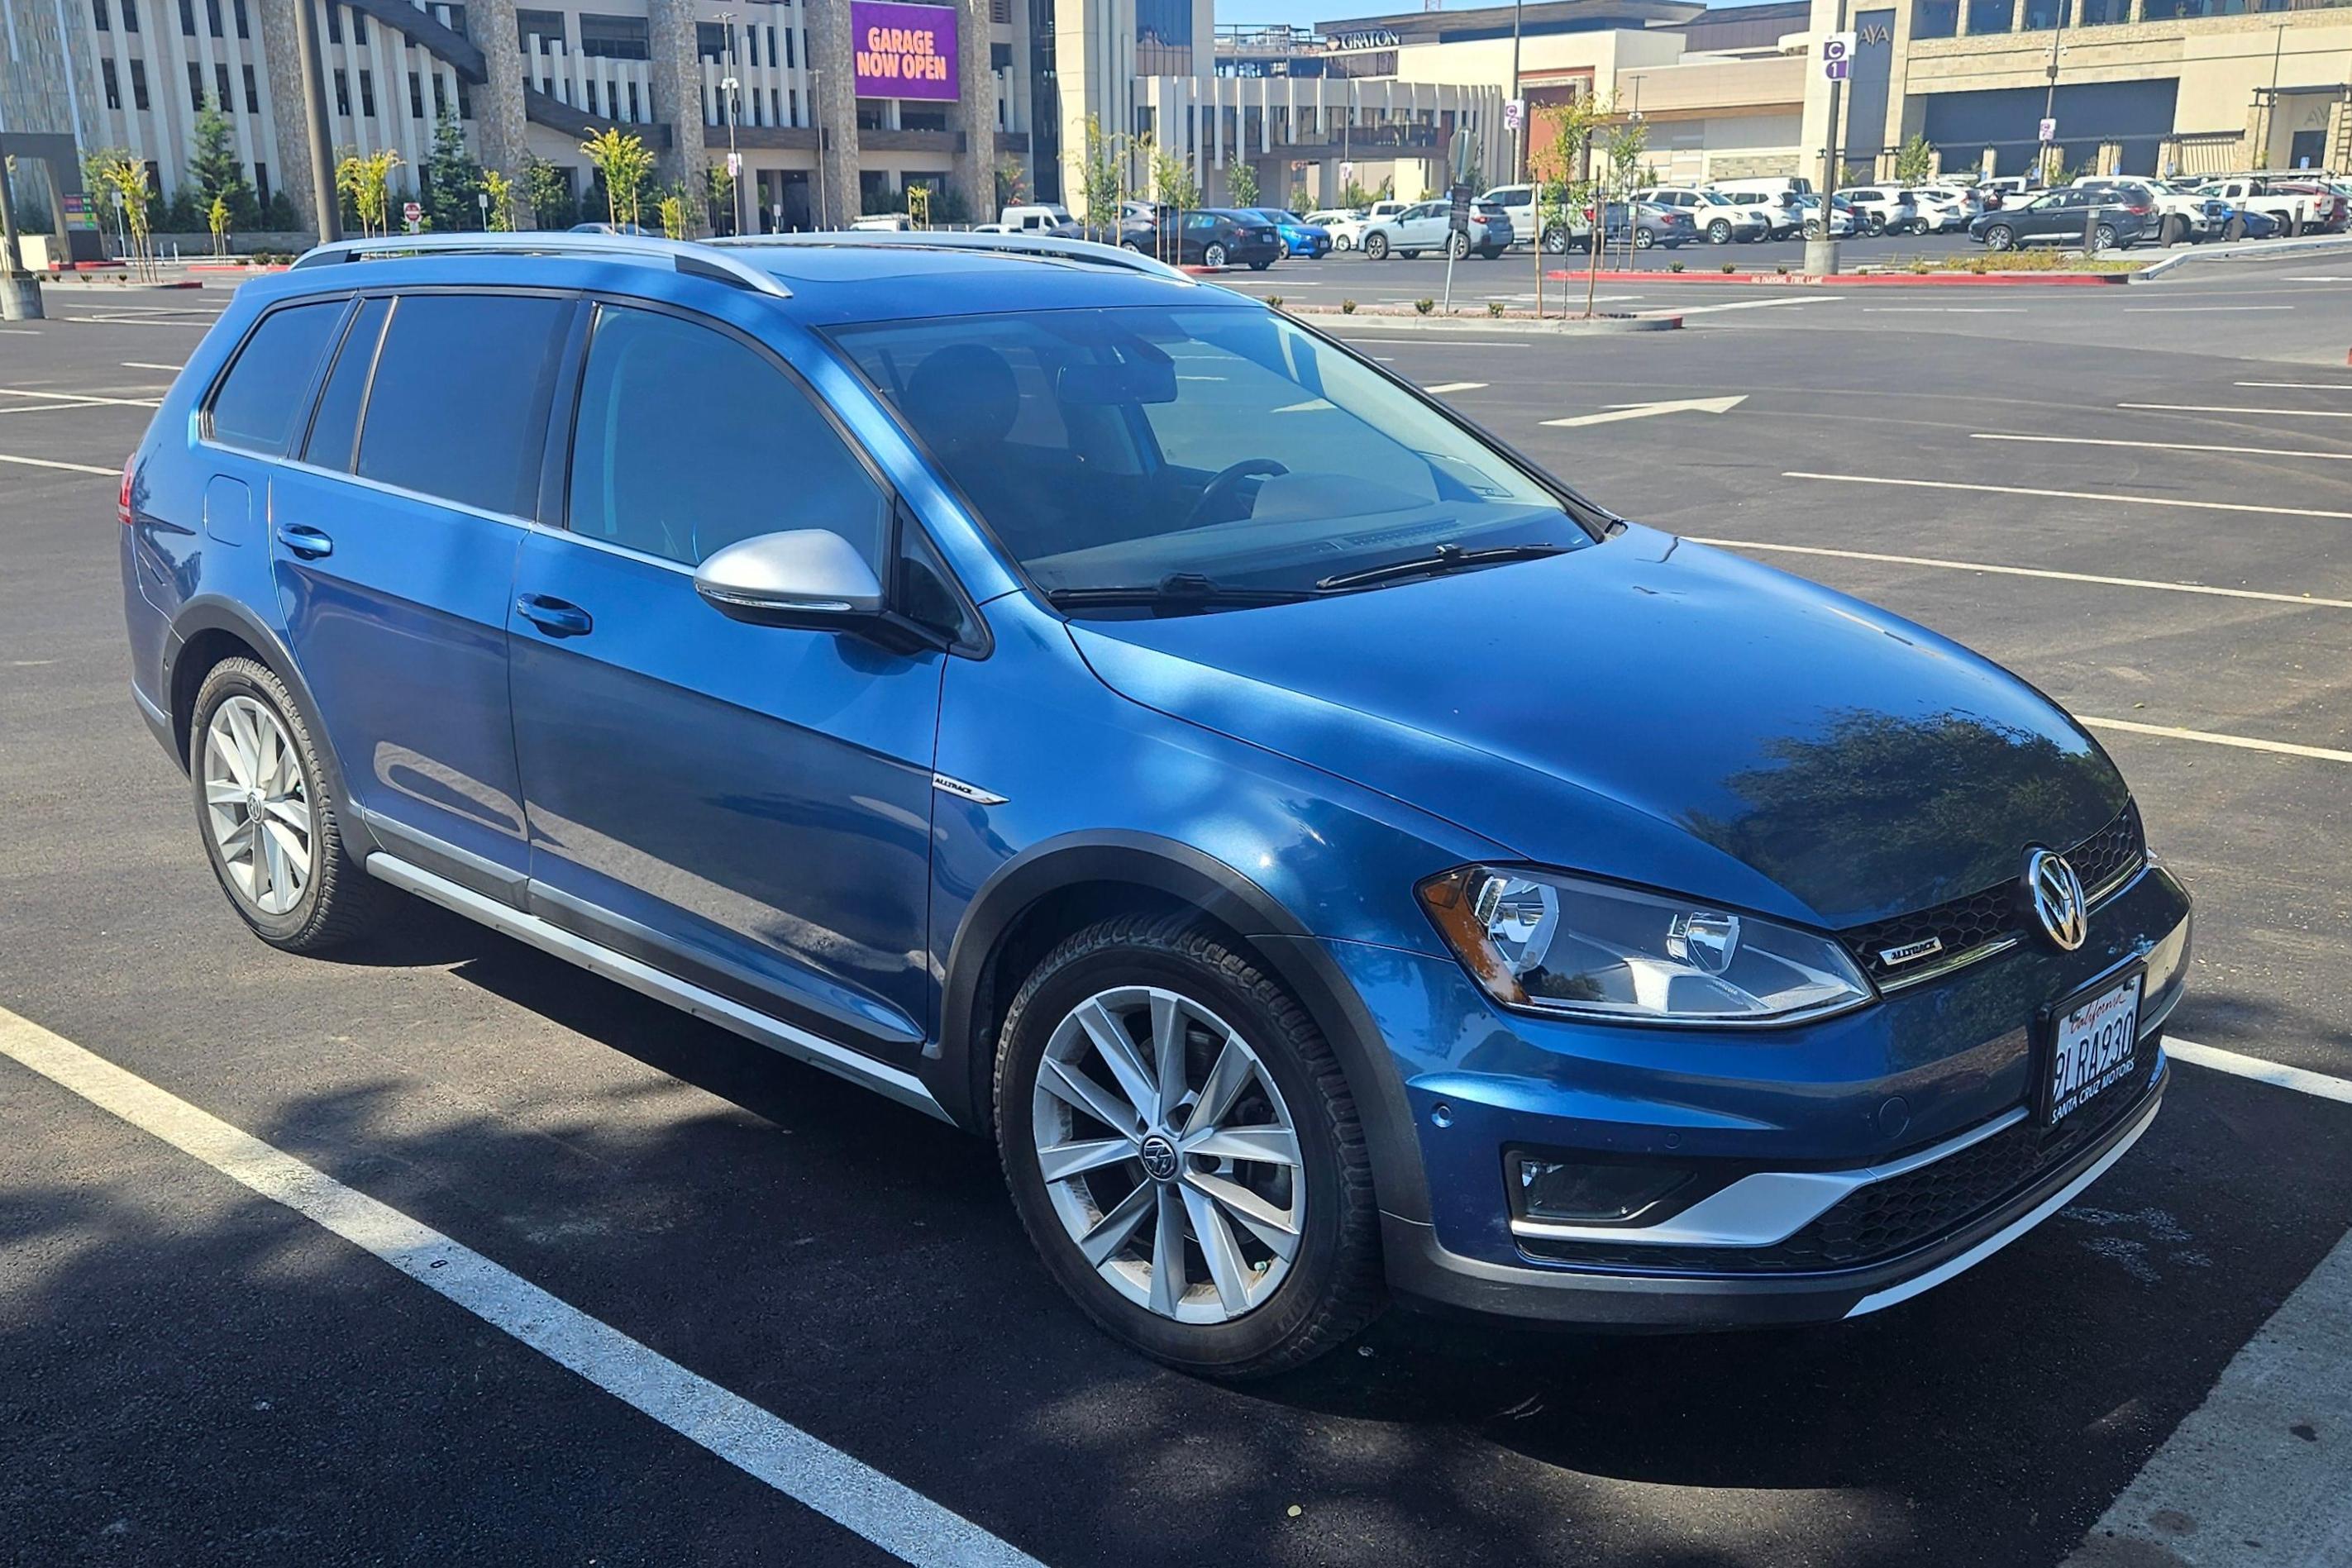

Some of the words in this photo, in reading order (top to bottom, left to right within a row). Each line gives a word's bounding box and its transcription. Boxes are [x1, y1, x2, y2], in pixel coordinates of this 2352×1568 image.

[868, 26, 934, 55] GARAGE
[1341, 29, 1400, 50] GRATON
[1858, 23, 1891, 45] AYA
[1828, 42, 1842, 59] C
[856, 51, 899, 78] NOW
[902, 54, 947, 80] OPEN
[2070, 994, 2126, 1034] California
[2053, 1010, 2134, 1097] 9LRA930
[2051, 1095, 2078, 1125] SANTA
[2078, 1079, 2101, 1104] CRUZ
[2101, 1057, 2135, 1089] MOTORS
